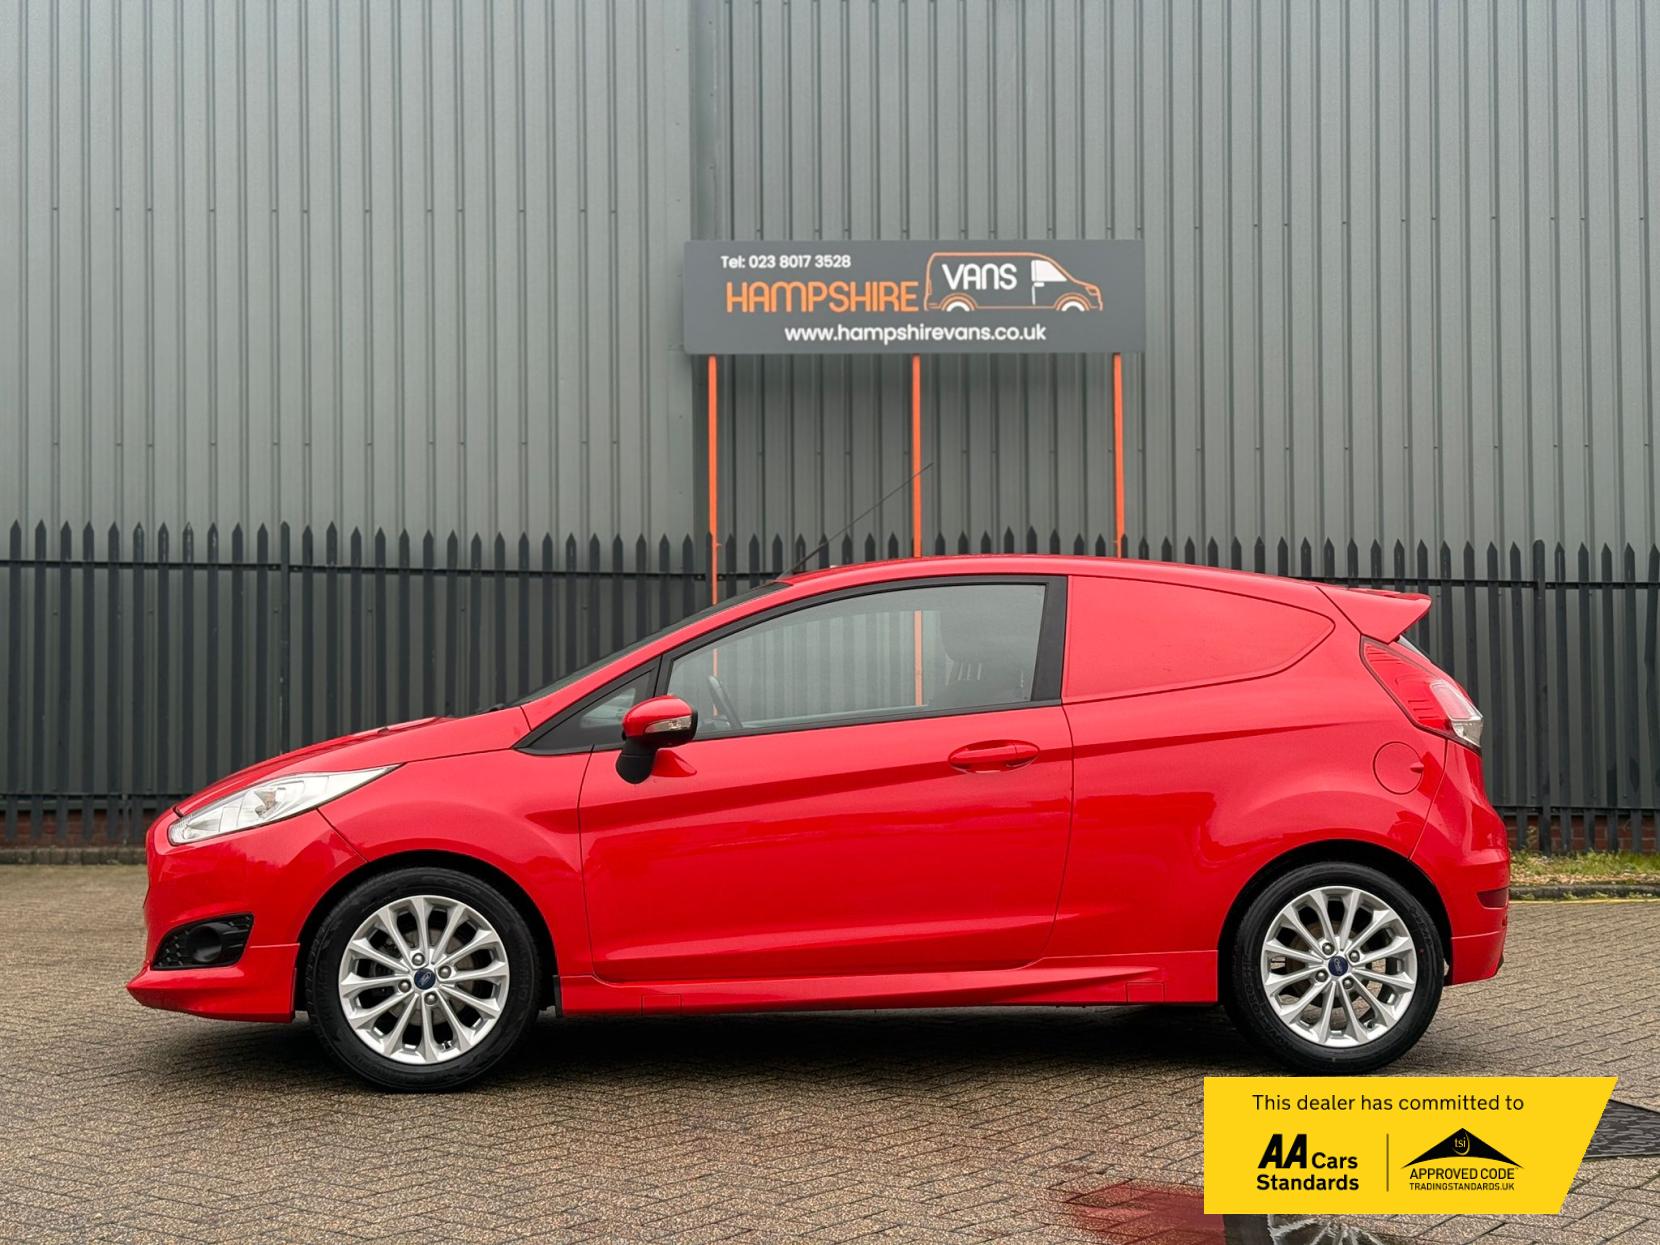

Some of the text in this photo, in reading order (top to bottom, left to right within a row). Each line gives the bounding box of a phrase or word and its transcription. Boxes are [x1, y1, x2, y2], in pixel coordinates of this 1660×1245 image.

[721, 255, 851, 269] Tel: 023 8017 3528
[941, 263, 1017, 291] VANS
[726, 280, 919, 313] HAMPSHIRE
[785, 324, 1047, 346] www.hampshirevans.co.uk
